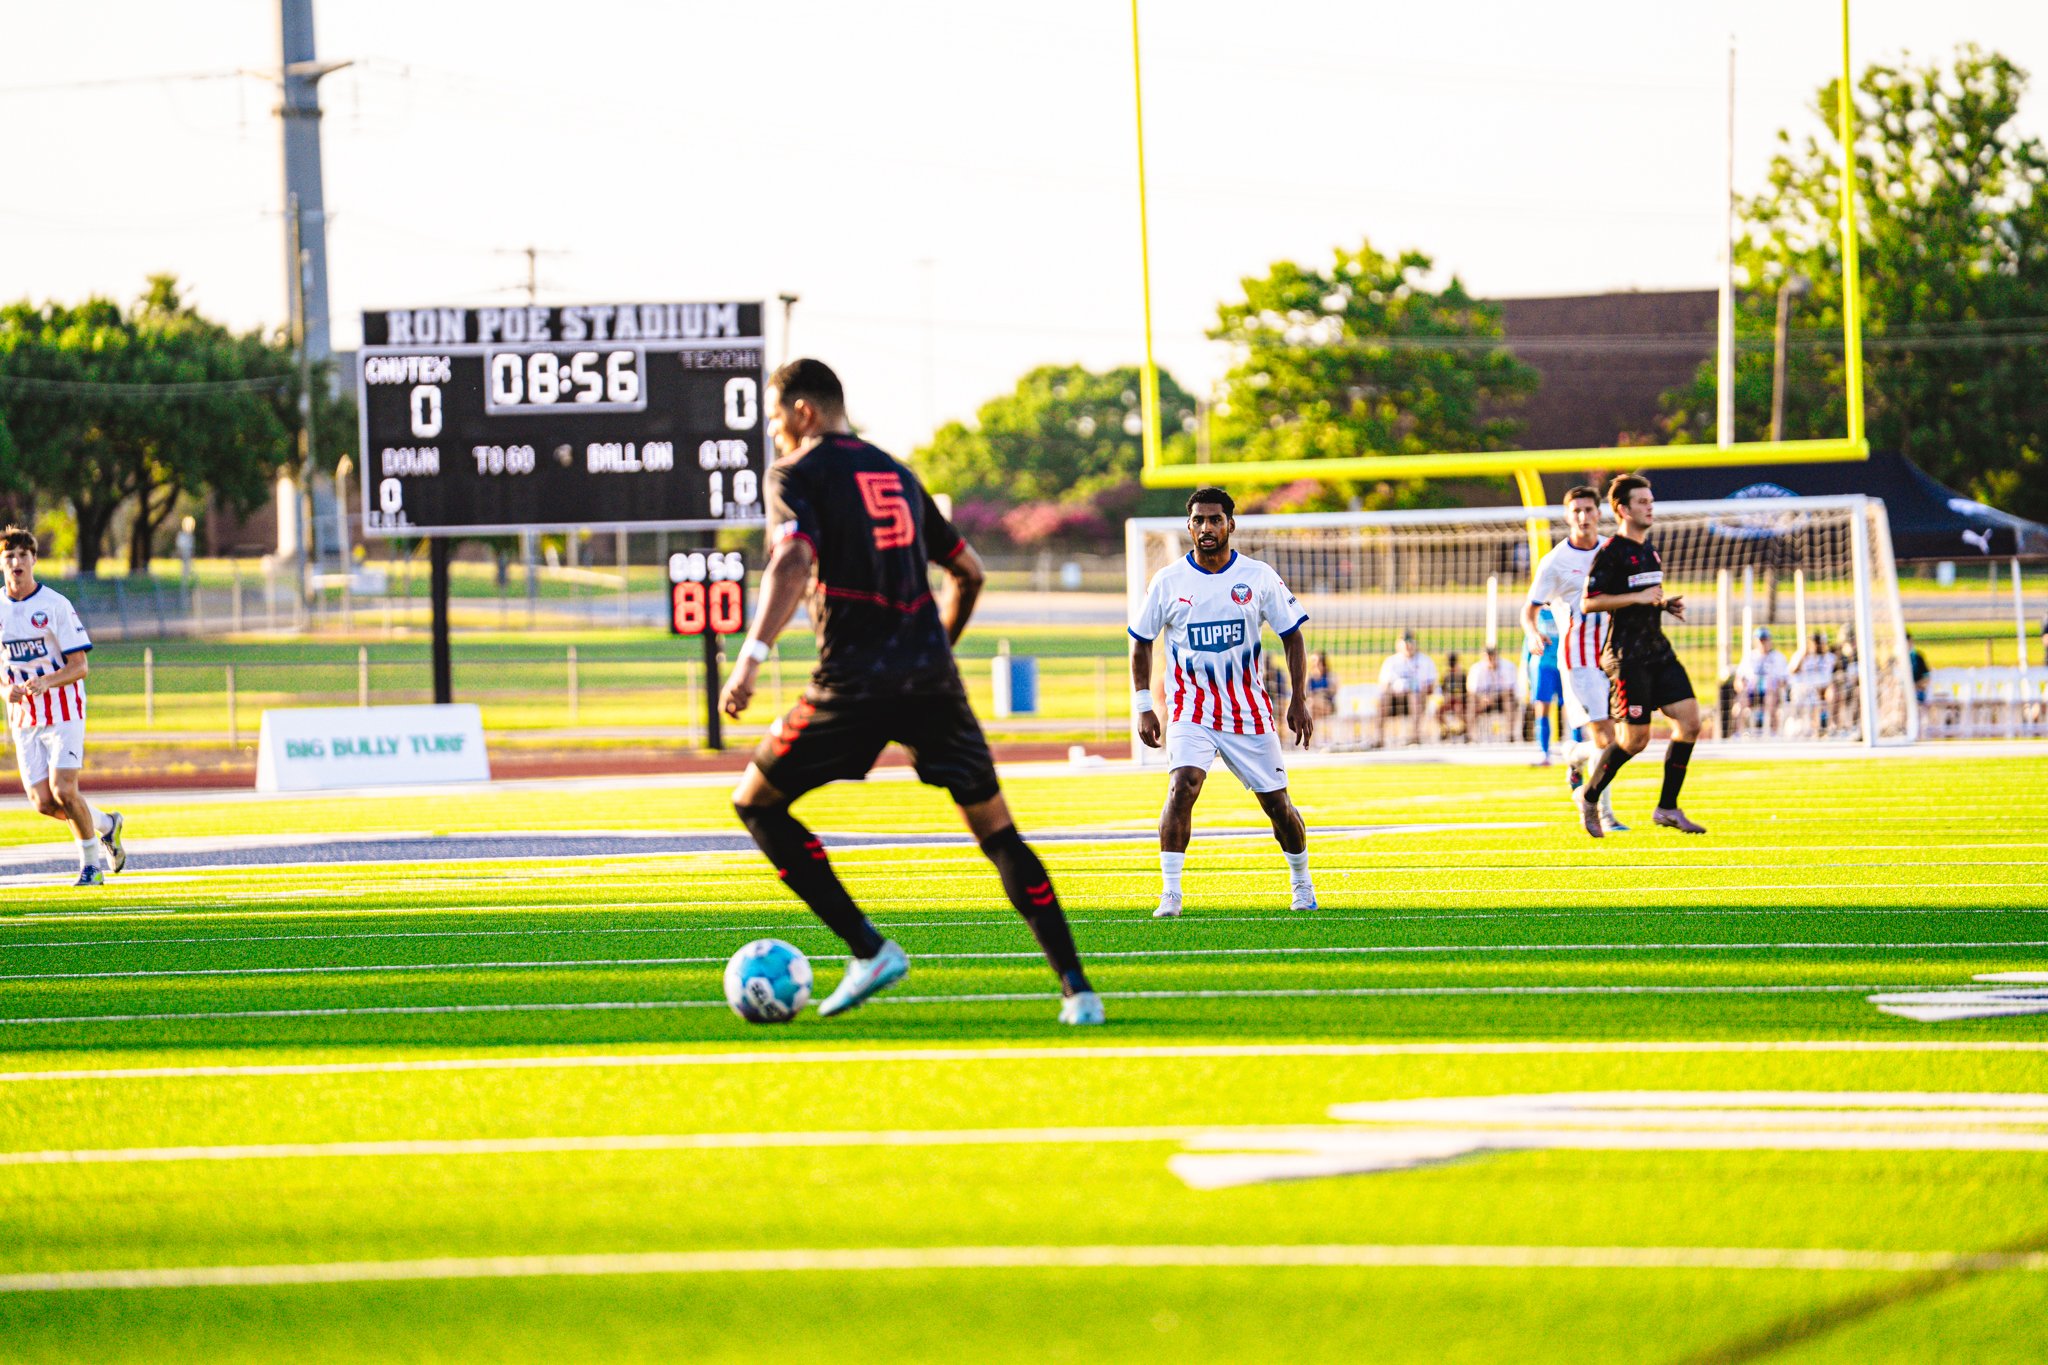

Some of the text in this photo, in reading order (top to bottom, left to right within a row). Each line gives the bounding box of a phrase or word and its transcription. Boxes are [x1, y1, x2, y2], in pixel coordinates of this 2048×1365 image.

[386, 303, 740, 344] RON POE STADIUM
[492, 350, 640, 405] 08:56
[410, 384, 442, 439] 0
[723, 376, 758, 431] 0
[382, 446, 440, 477] DOWN
[699, 439, 749, 470] QTR
[379, 477, 402, 514] 0
[853, 471, 916, 551] 5
[673, 580, 743, 635] 80
[4, 639, 47, 661] TUPPS
[1190, 623, 1243, 647] TUPPS
[285, 732, 466, 758] BIG BULLY TURF
